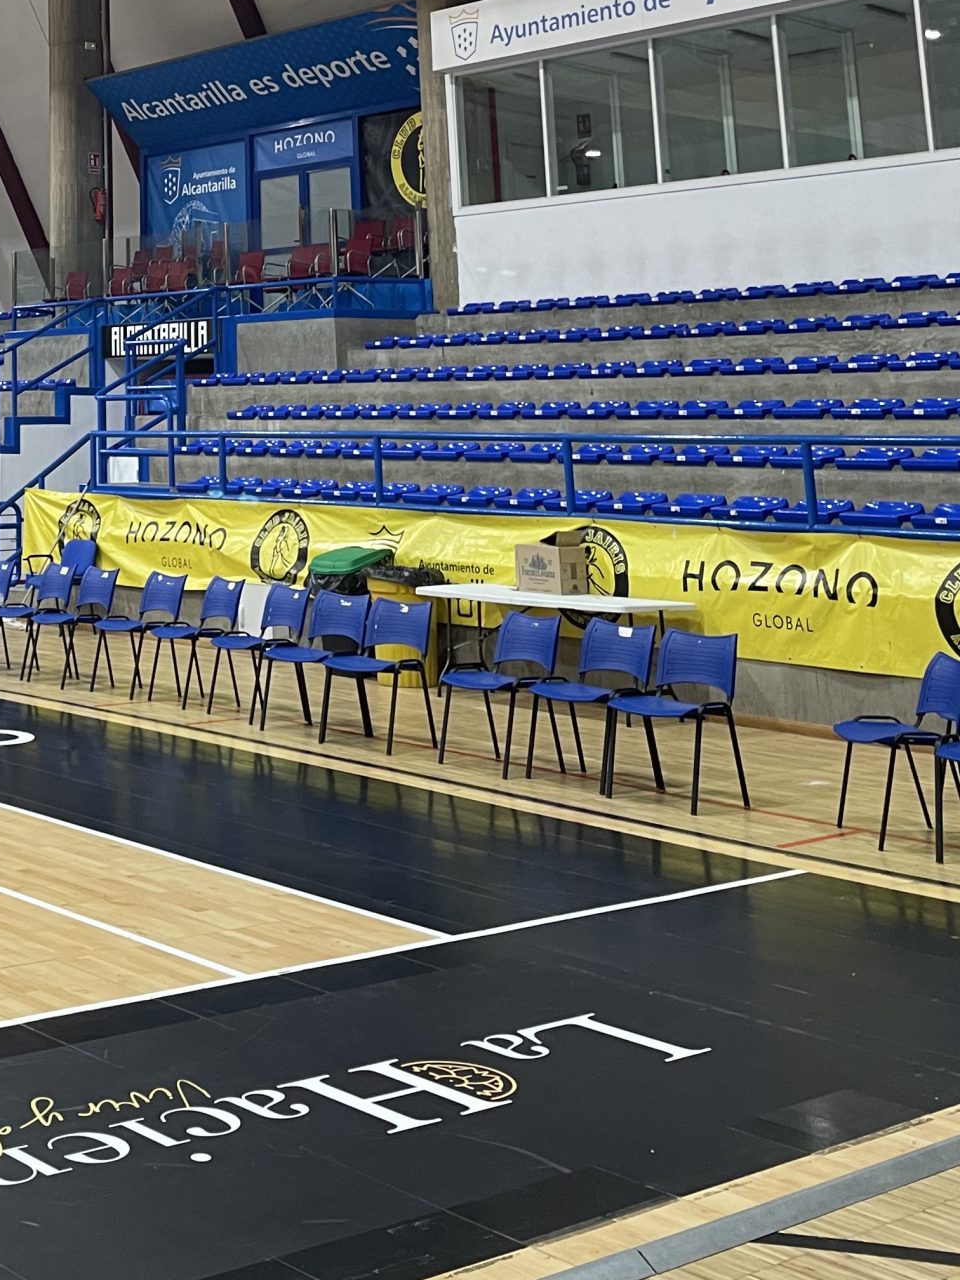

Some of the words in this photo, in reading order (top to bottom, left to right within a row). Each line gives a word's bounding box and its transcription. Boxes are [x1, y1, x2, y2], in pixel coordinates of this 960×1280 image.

[121, 80, 247, 122] Alcantarilla
[249, 68, 281, 94] es
[281, 46, 393, 89] deporte
[274, 129, 336, 154] HOZONO
[297, 150, 317, 160] GLOBAL
[192, 167, 227, 180] Ayuntamiento
[228, 166, 236, 174] de
[181, 176, 237, 197] Alcantarilla
[126, 520, 228, 551] HOZONO
[161, 556, 193, 570] GLOBAL
[585, 528, 626, 575] JAIRIS
[419, 558, 481, 575] Ayuntamiento
[482, 563, 495, 576] de
[682, 559, 880, 608] HOZONO
[752, 612, 815, 634] GLOBAL
[460, 1013, 712, 1064] La
[19, 1095, 64, 1130] y
